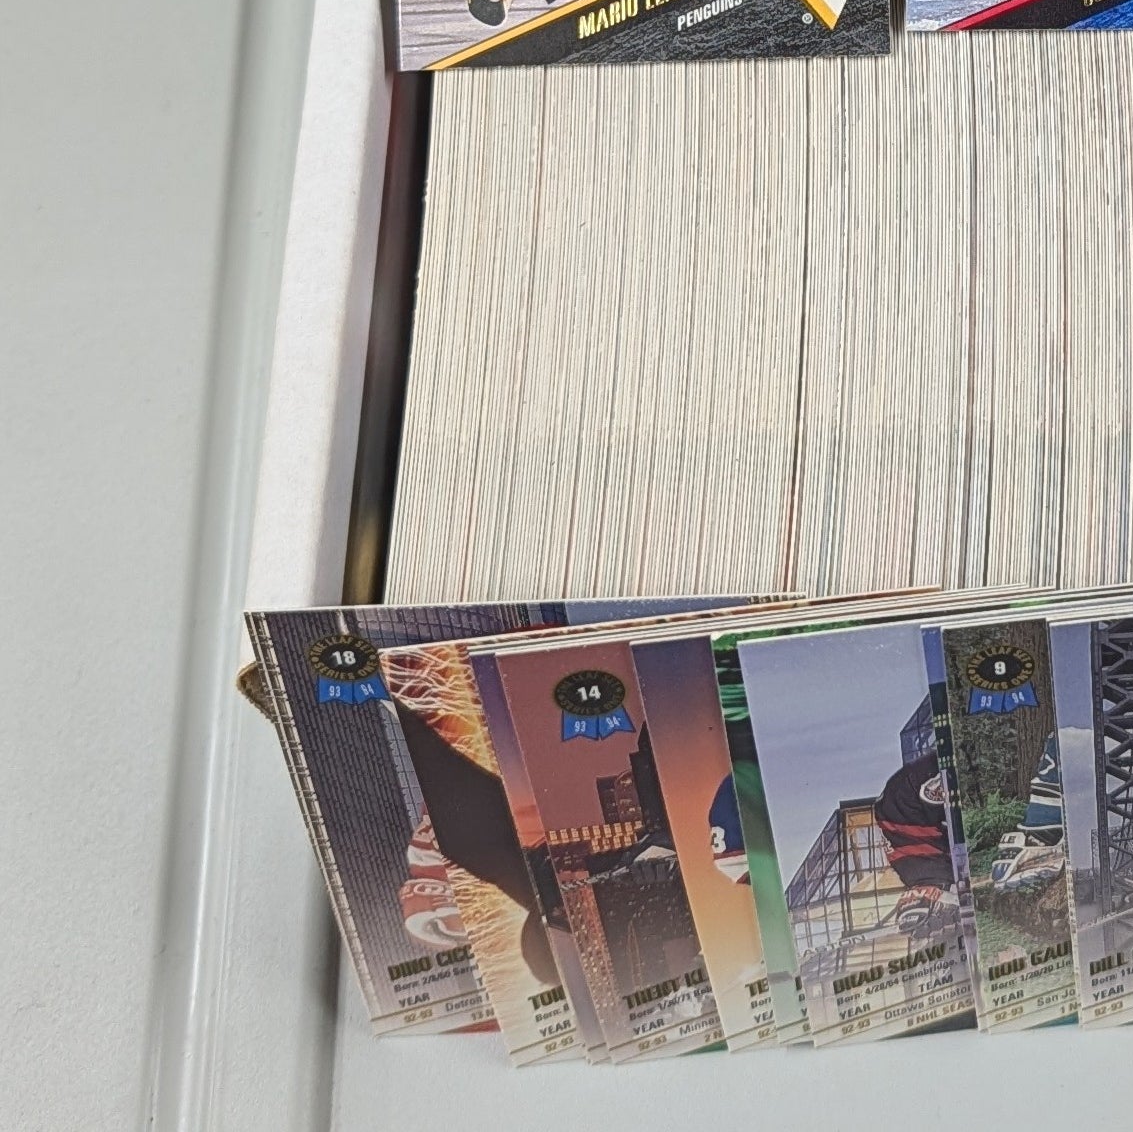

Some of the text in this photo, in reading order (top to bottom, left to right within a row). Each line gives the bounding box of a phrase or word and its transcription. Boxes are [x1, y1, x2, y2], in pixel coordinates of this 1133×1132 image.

[331, 650, 356, 666] 18
[314, 660, 378, 680] SERIES ONE
[994, 661, 1006, 675] 9
[329, 685, 341, 697] 93
[577, 685, 601, 701] 14
[981, 695, 992, 707] 93
[574, 720, 586, 733] 93
[387, 955, 432, 981] DINO
[1089, 952, 1128, 977] BILL
[832, 964, 886, 995] BRAD
[399, 992, 431, 1008] YEAR
[839, 973, 954, 1020] YEAR TEAM
[992, 989, 1025, 1007] YEAR
[1092, 984, 1125, 1002] YEAR
[994, 988, 1076, 1022] 92-93 San Jo
[1094, 1000, 1124, 1017] 92-93
[841, 1018, 871, 1035] 92-93
[884, 1000, 925, 1020] Ottawa
[916, 1011, 939, 1024] NHL
[539, 1019, 572, 1037] YEAR
[632, 1018, 665, 1036] YEAR
